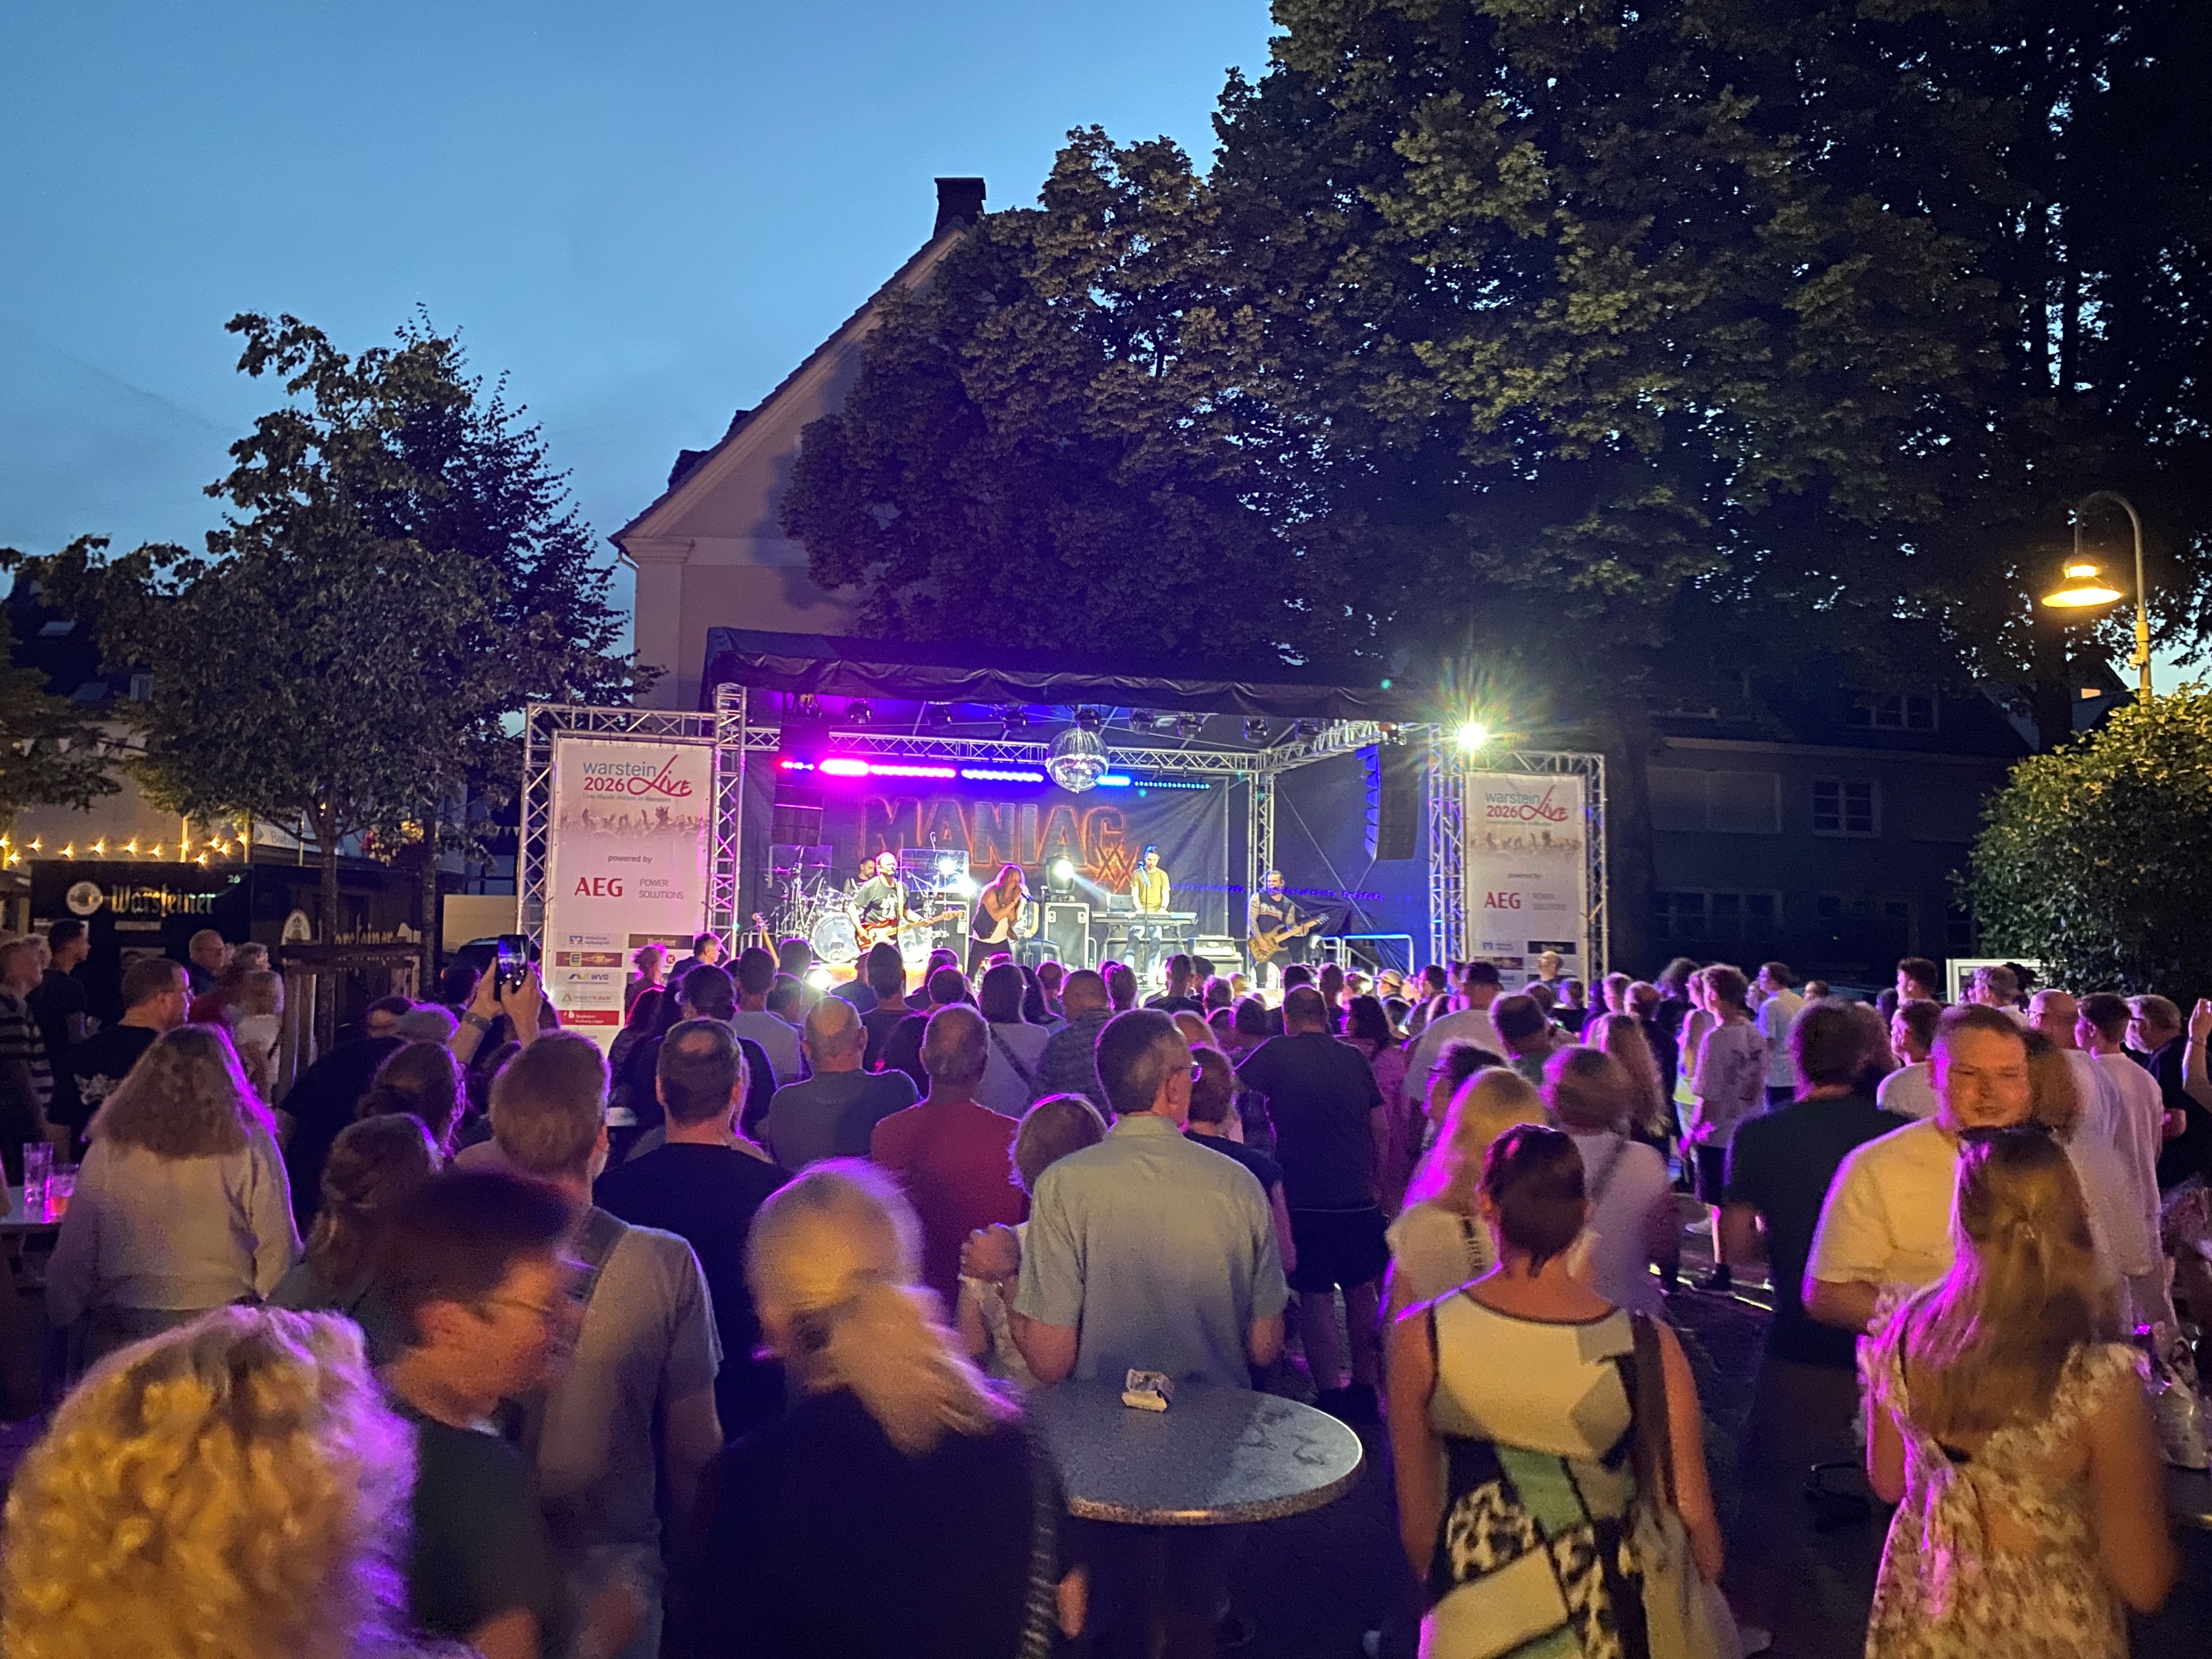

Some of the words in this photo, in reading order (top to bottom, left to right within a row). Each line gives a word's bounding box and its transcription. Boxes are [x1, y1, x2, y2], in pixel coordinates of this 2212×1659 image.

[583, 761, 656, 777] warstein
[584, 777, 625, 792] 2026
[1485, 791, 1540, 804] warstein
[1487, 805, 1517, 817] 2026
[860, 795, 1126, 868] MANIAC
[228, 875, 240, 884] 26
[574, 877, 623, 897] AEG
[111, 883, 216, 917] Warsteiner
[639, 890, 684, 899] SOLUTIONS
[1485, 892, 1521, 909] AEG
